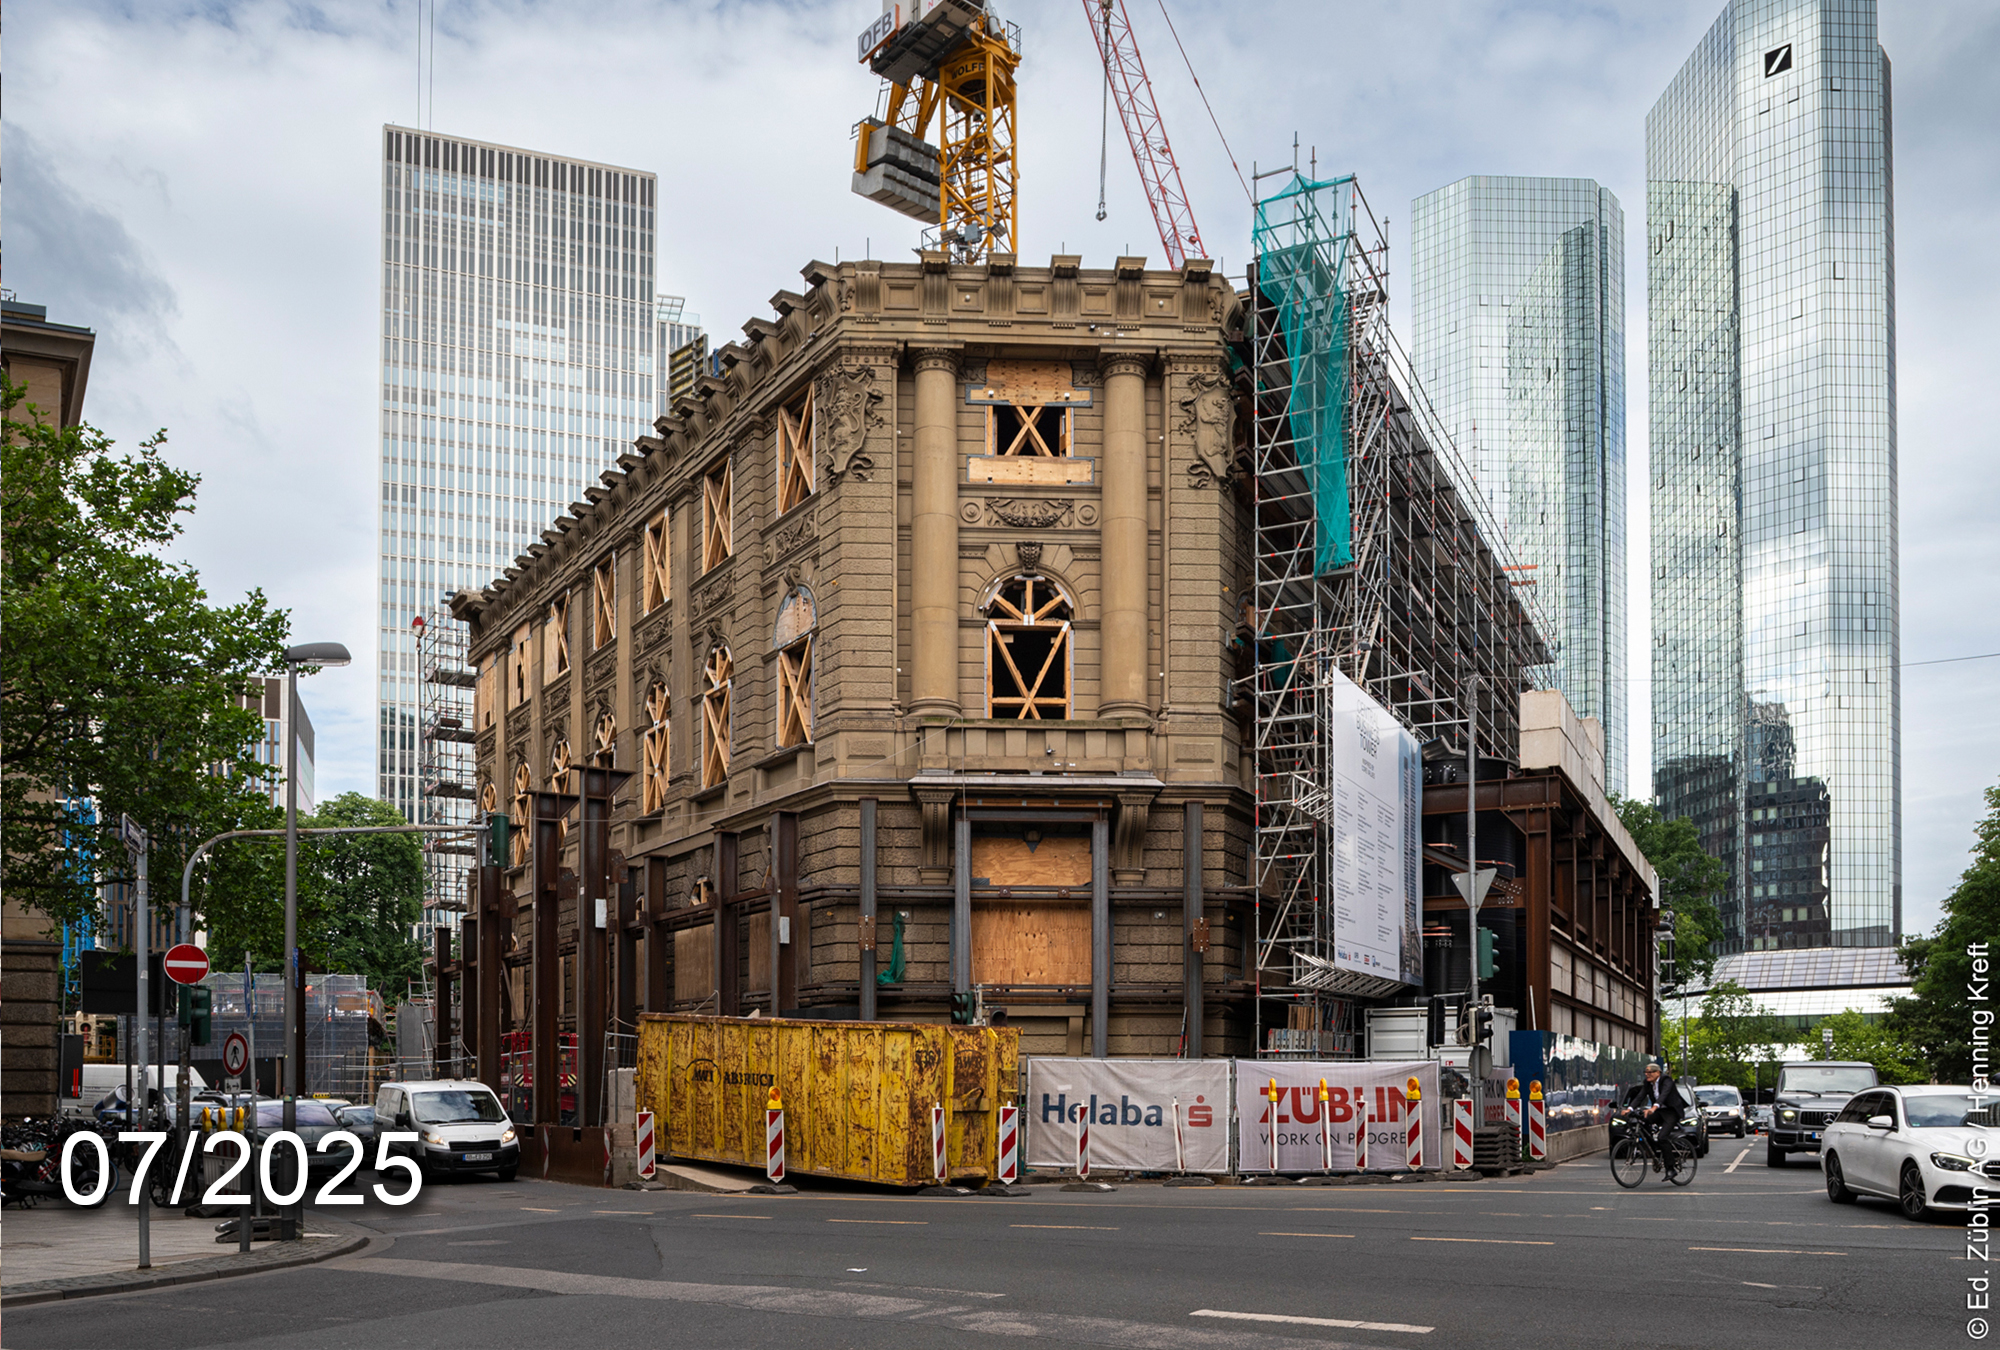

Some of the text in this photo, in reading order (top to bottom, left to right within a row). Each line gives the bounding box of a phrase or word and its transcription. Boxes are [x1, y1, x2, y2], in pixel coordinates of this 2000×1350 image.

[860, 11, 892, 55] OFB
[951, 62, 985, 80] WOLFF
[1042, 1093, 1163, 1127] Helaba
[1259, 1086, 1422, 1124] ZÜBLIN
